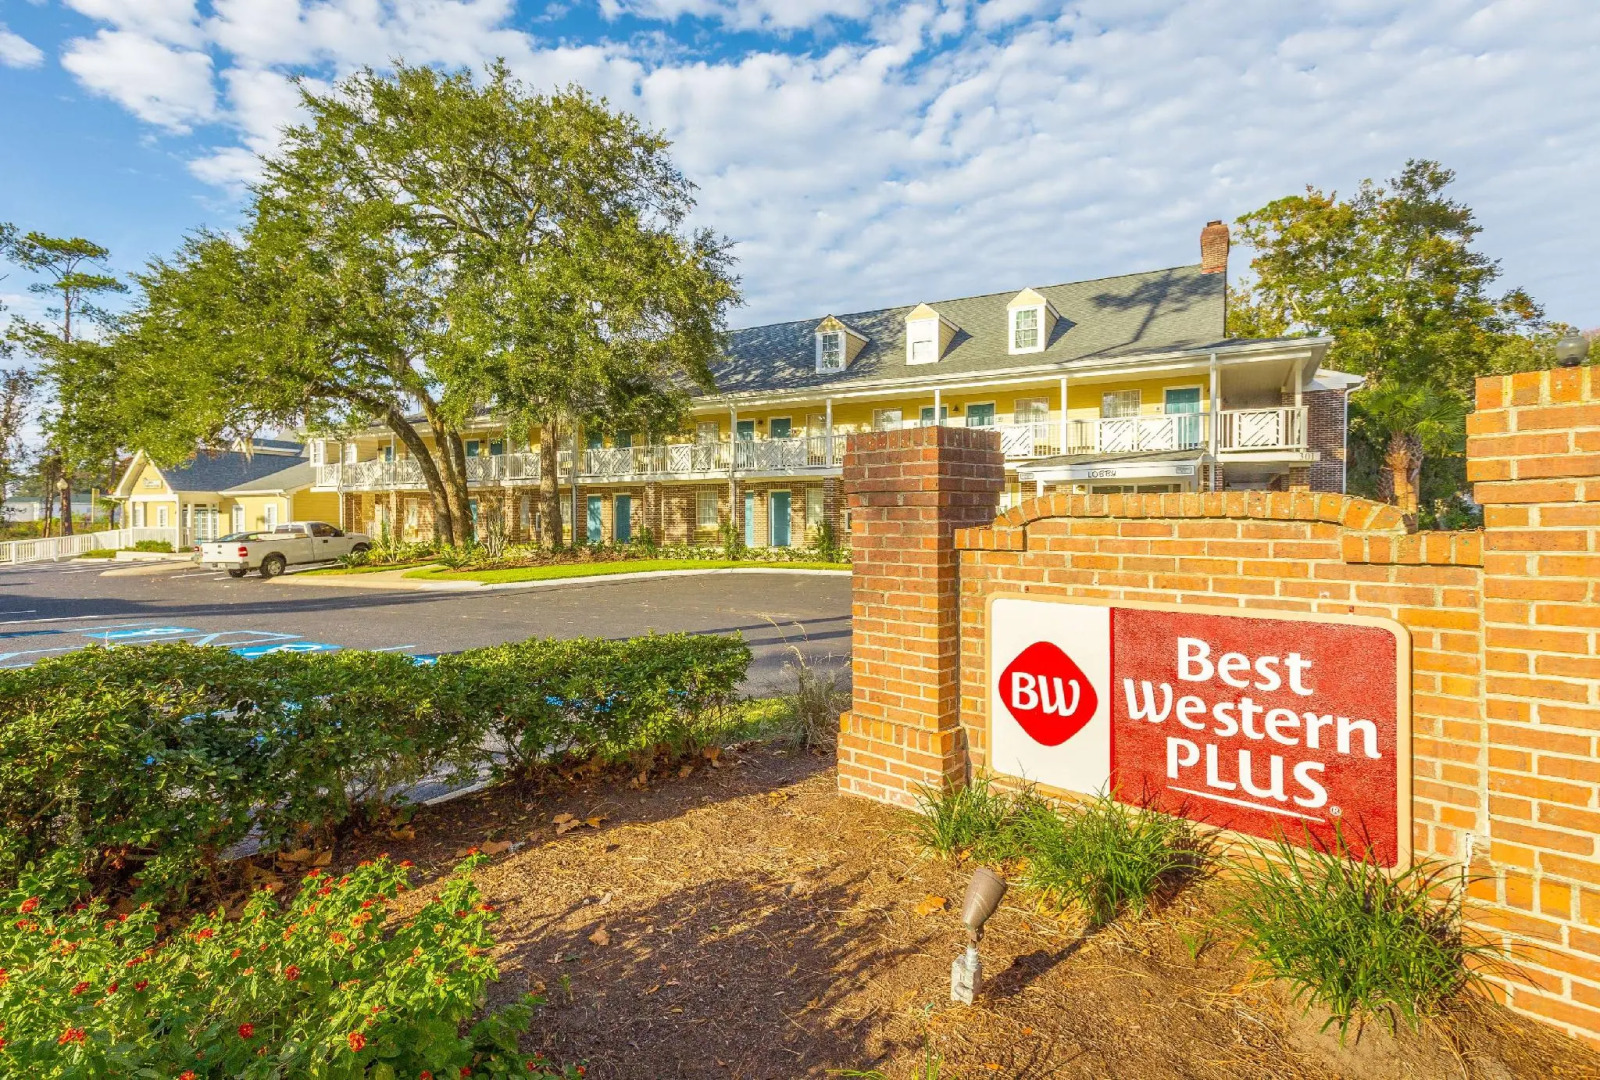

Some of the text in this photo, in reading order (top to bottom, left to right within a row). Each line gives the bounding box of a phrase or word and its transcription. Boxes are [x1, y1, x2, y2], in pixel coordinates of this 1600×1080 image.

[1087, 469, 1117, 479] LOBBY
[1299, 452, 1315, 461] 301
[1177, 636, 1314, 696] Best
[1011, 671, 1081, 717] BW
[1123, 677, 1382, 759] Western
[1166, 736, 1328, 808] PLUS
